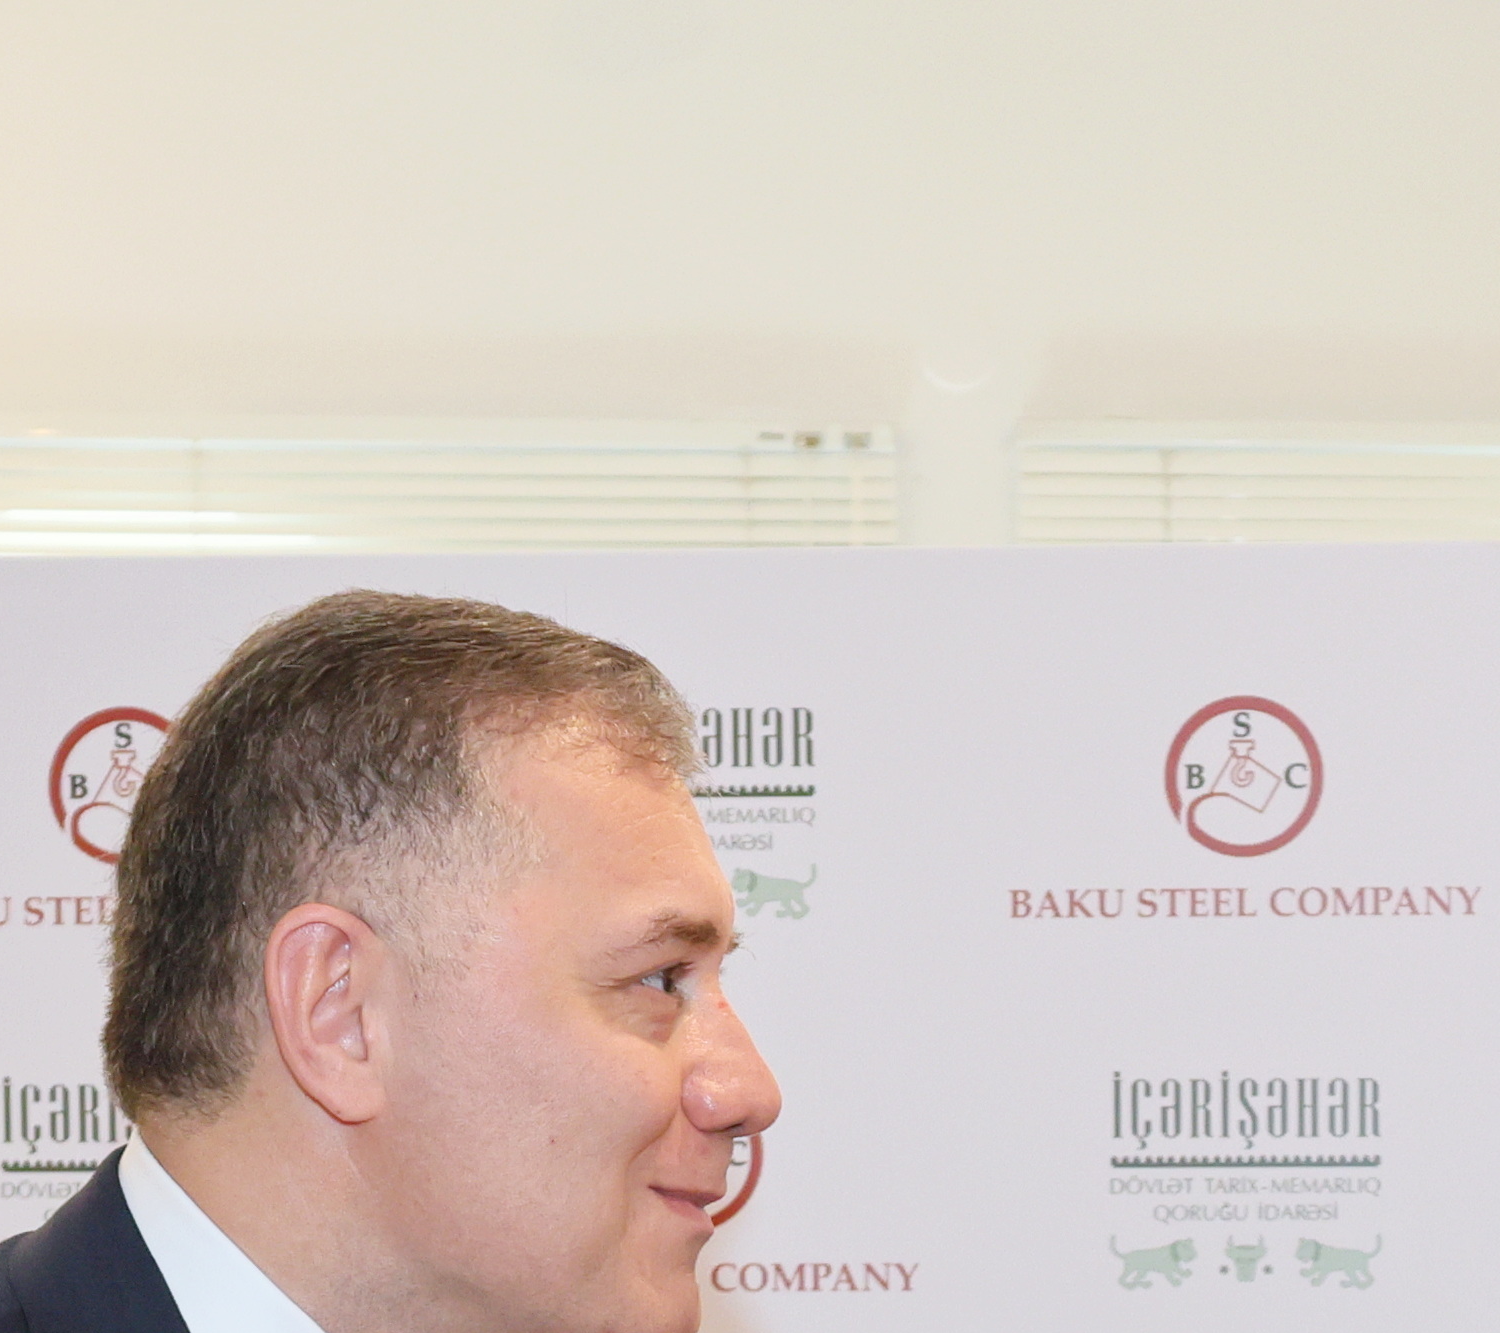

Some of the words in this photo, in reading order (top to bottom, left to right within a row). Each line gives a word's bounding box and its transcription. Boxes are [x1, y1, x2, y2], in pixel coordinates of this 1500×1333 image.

[1234, 712, 1250, 737] S
[1186, 764, 1205, 789] B
[1285, 763, 1306, 789] C
[1009, 889, 1124, 919] BAKU
[1137, 888, 1257, 918] STEEL
[1269, 886, 1480, 917] COMPANY
[1109, 1175, 1193, 1195] DÖVLƏT
[1153, 1202, 1248, 1225] QORUĞU
[710, 1262, 920, 1294] COMPANY
